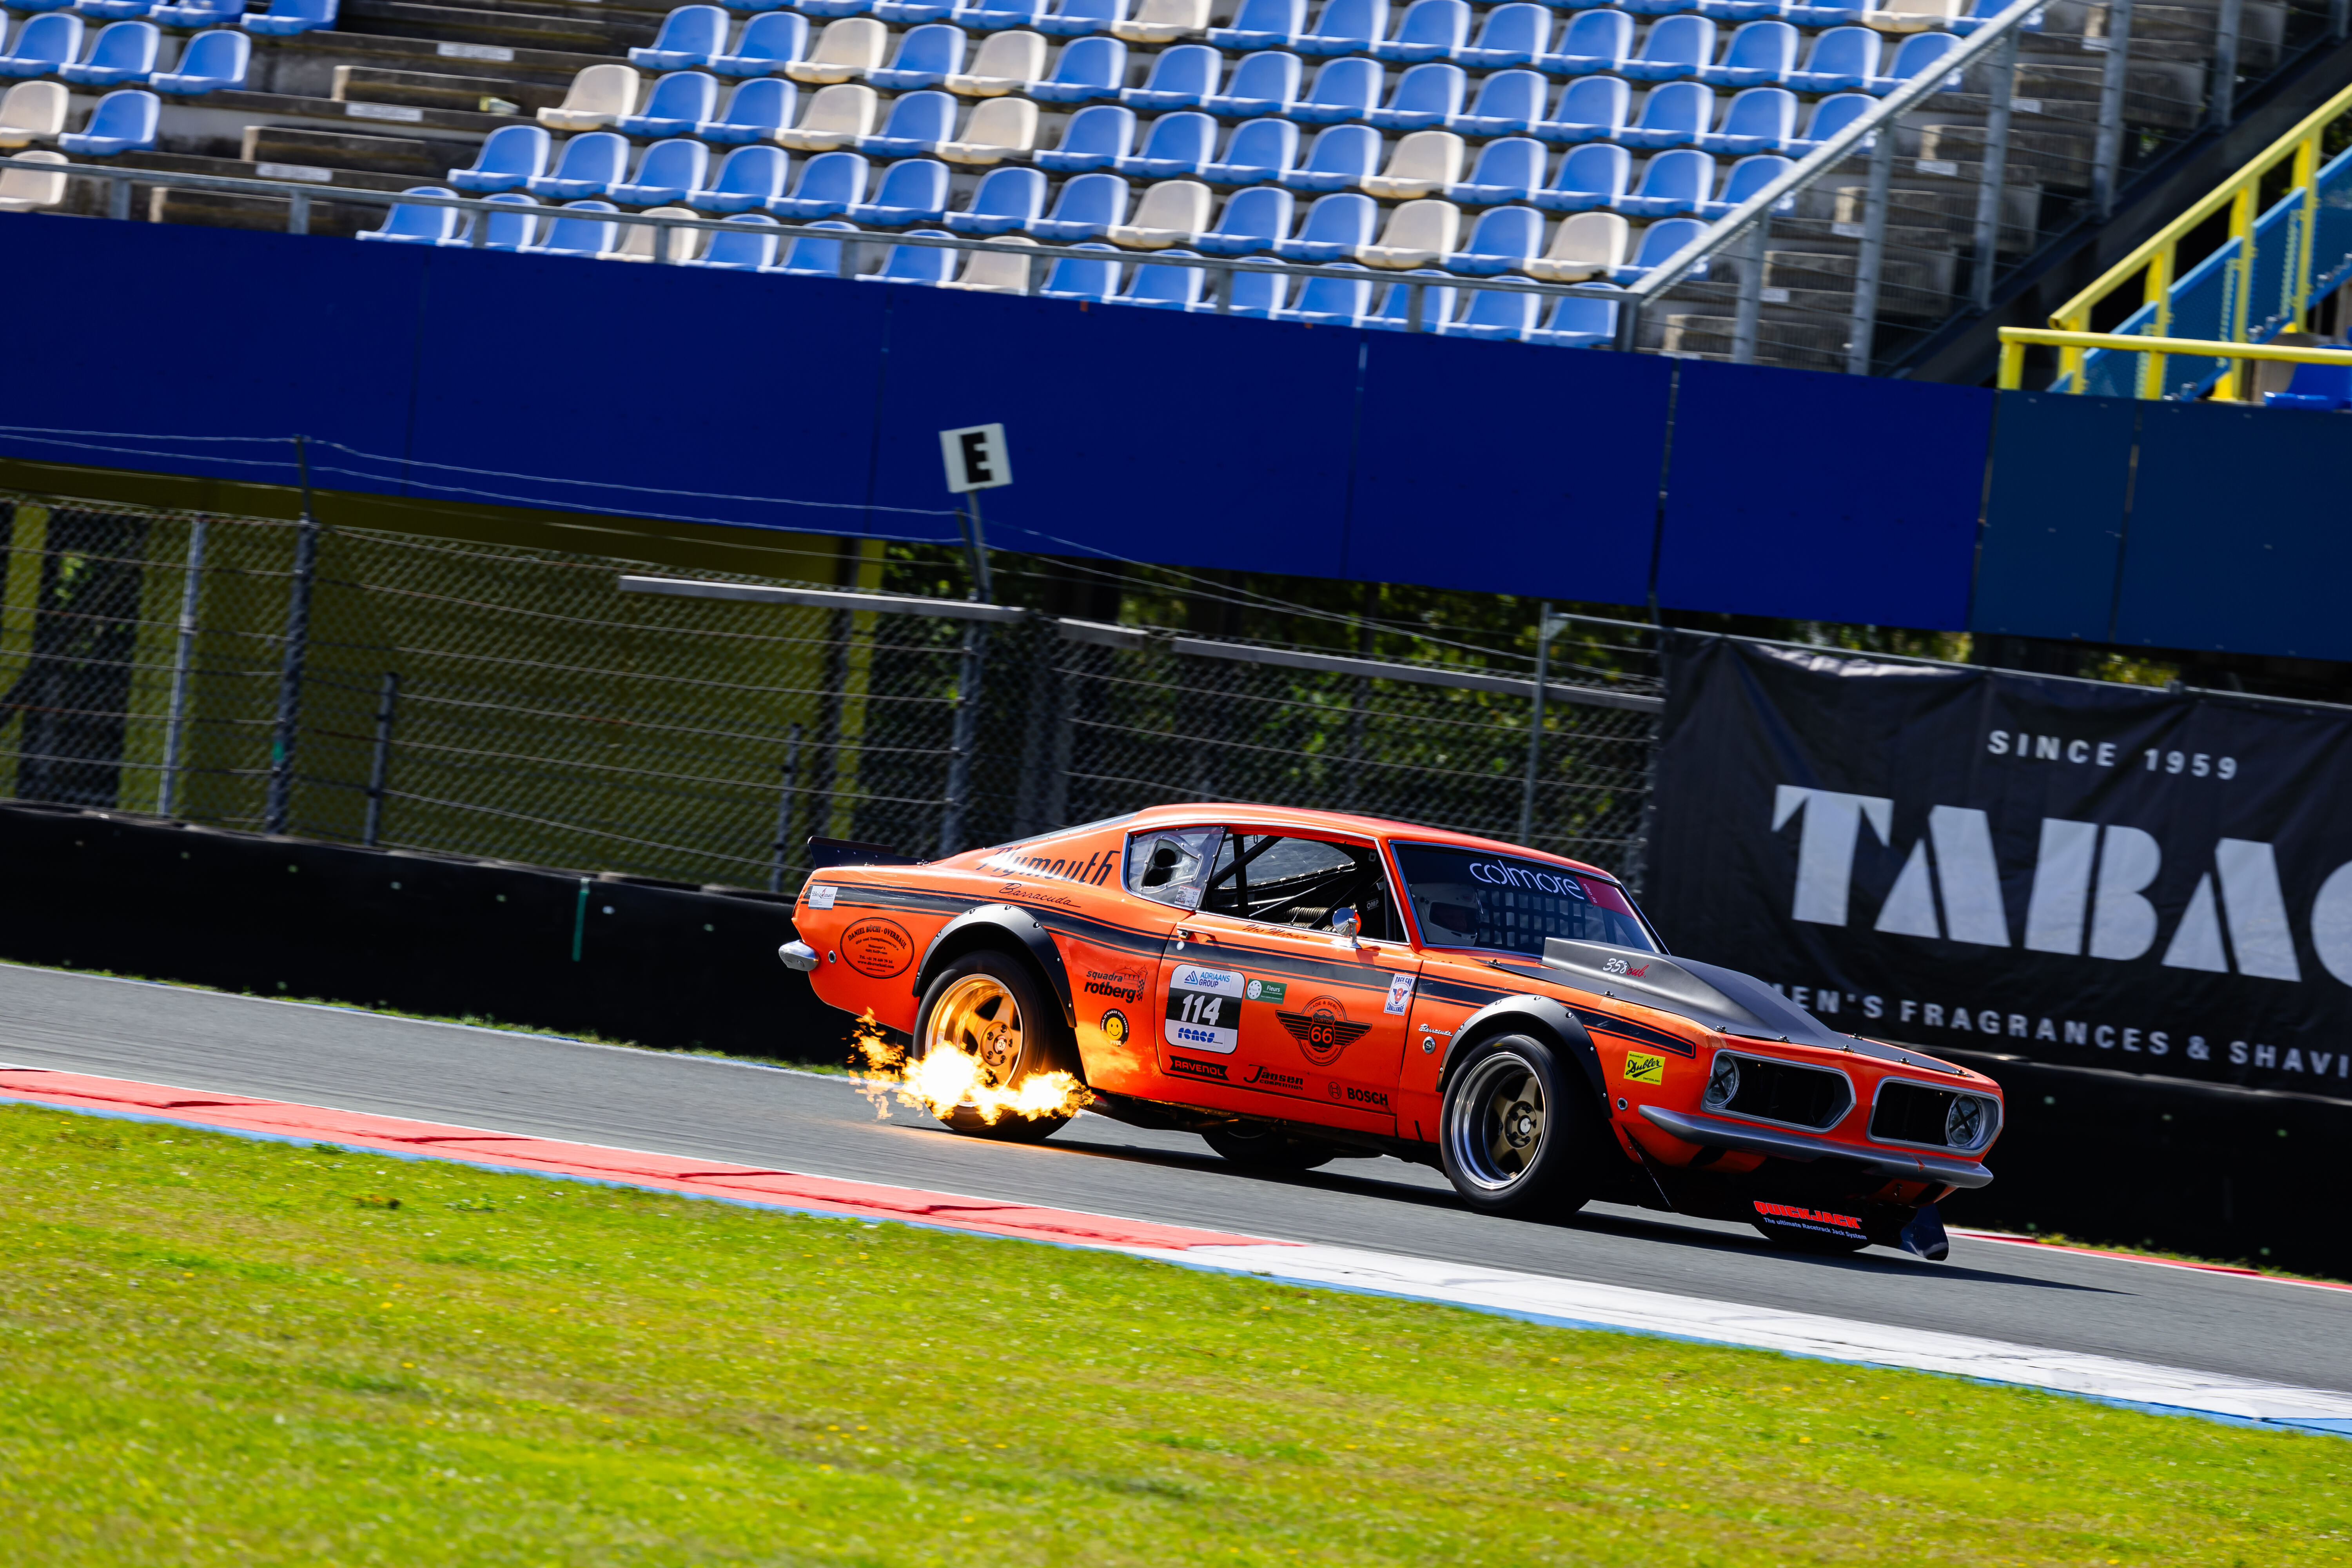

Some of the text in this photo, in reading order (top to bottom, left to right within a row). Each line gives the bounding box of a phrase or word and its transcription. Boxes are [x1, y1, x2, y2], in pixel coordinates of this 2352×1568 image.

[959, 432, 993, 483] E
[1987, 730, 2238, 780] SINCE 1959
[976, 846, 1120, 886] Plymouth
[1470, 860, 1584, 900] colmore
[999, 883, 1081, 908] Barracuda
[1367, 900, 1379, 909] OMP
[848, 927, 865, 941] DANIEL
[866, 924, 881, 933] BÜCHI
[884, 928, 906, 949] OVERHAUL
[1086, 971, 1123, 982] squadra
[1200, 972, 1230, 982] ADRIAANS
[1626, 964, 1649, 978] cub.
[1084, 982, 1136, 1004] rotberg
[1199, 979, 1219, 988] GROUP
[1181, 994, 1222, 1025] 114
[1307, 1001, 1321, 1013] TRADE
[1387, 1002, 1404, 1013] CHALLENGE
[1311, 1026, 1332, 1044] 66
[1419, 1023, 1453, 1036] Barracuda
[1900, 1000, 2170, 1055] FRAGRANCES
[2186, 1035, 2210, 1060] &
[2229, 1040, 2349, 1078] SHAVI
[1175, 1060, 1223, 1076] RAVENOL
[1243, 1064, 1303, 1085] Jansen
[1626, 1058, 1662, 1076] Dubler
[1259, 1079, 1303, 1090] COMPETITION
[1347, 1087, 1388, 1106] BOSCH
[1753, 1201, 1861, 1229] QUICKJACK
[1777, 1220, 1801, 1228] ultimate
[1802, 1223, 1831, 1233] Racetrack
[1845, 1231, 1867, 1240] System
